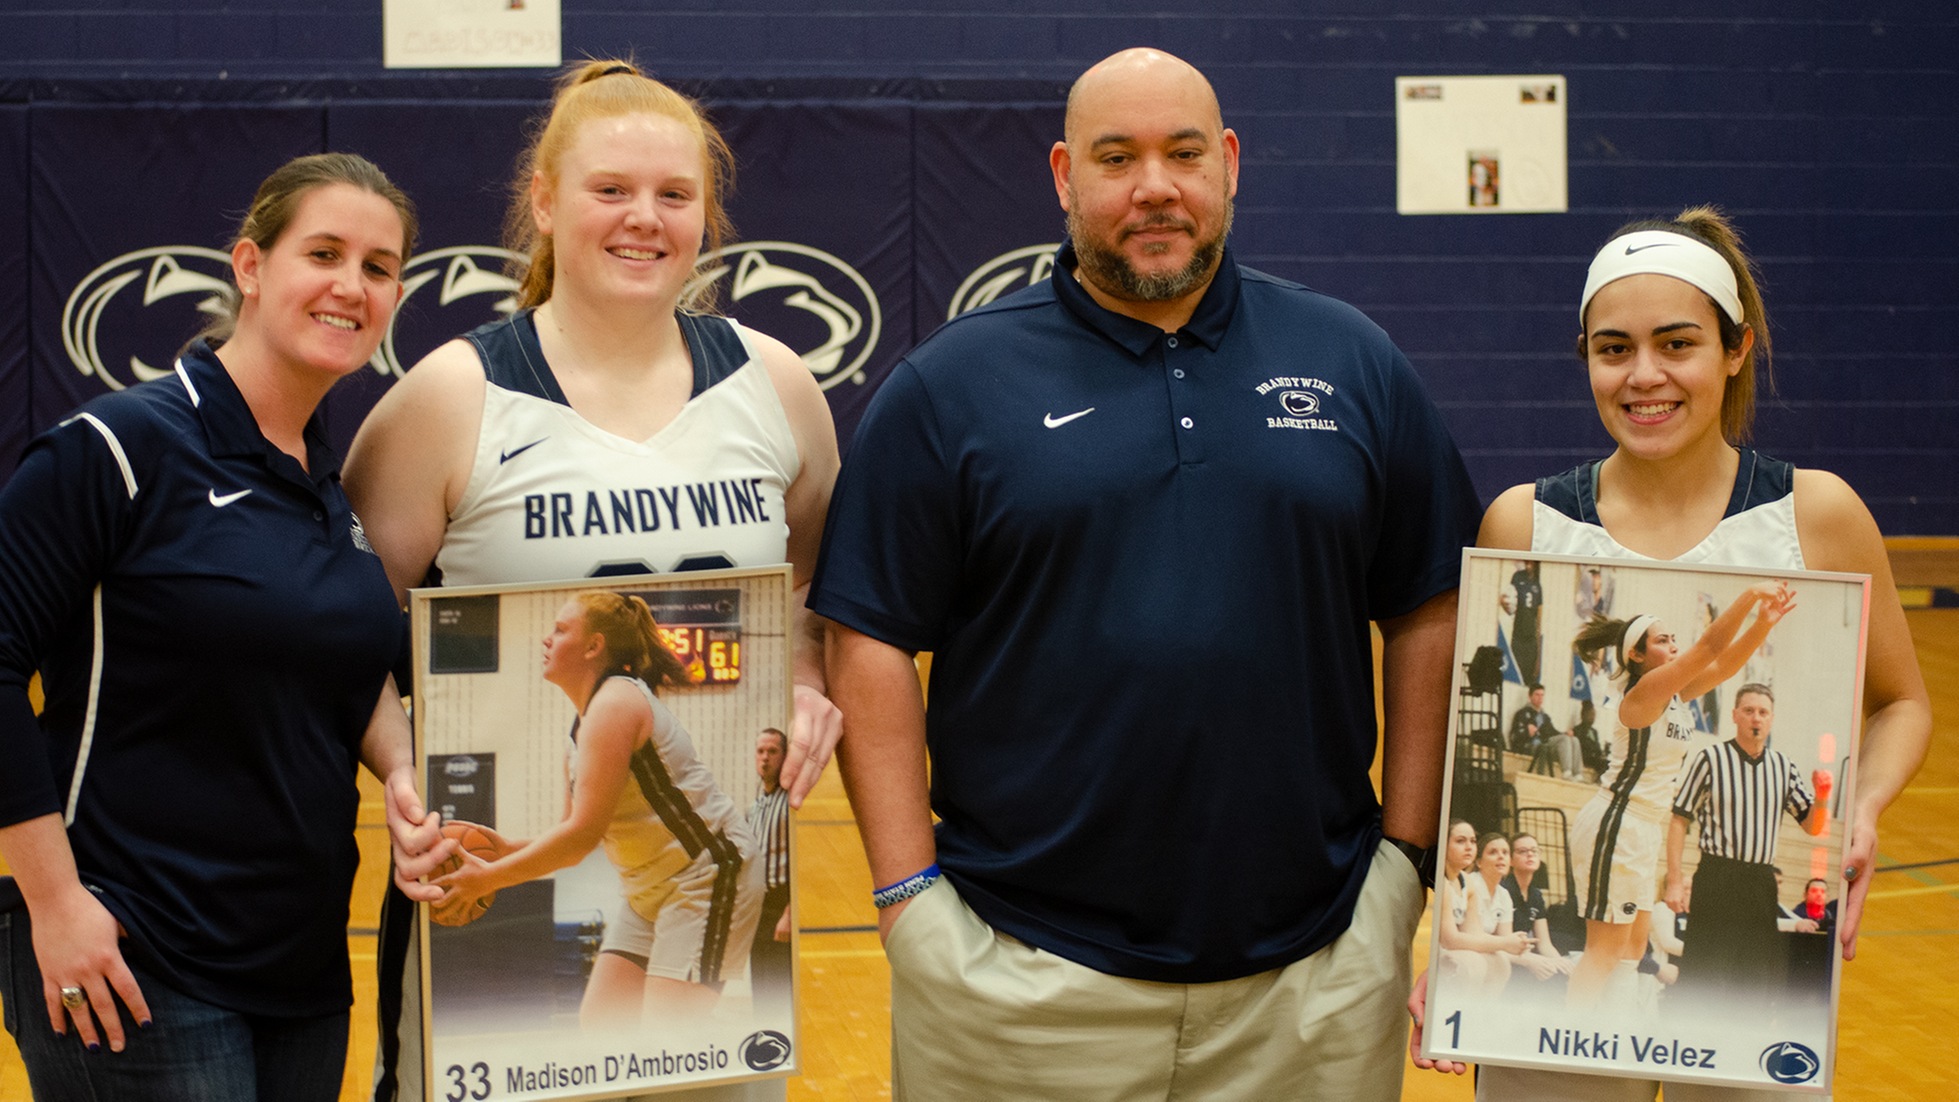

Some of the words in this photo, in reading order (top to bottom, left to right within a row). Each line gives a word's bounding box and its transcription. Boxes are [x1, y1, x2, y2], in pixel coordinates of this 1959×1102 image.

[1255, 377, 1334, 395] BRANDYWINE
[1266, 417, 1338, 431] BASKETBALL
[525, 478, 770, 539] BRANDYWINE
[1444, 1010, 1462, 1049] 1
[1538, 1027, 1619, 1060] Nikki
[1631, 1035, 1717, 1069] Velez
[446, 1061, 492, 1102] 33
[506, 1062, 597, 1093] Madison
[604, 1044, 728, 1082] D'Ambrosio
